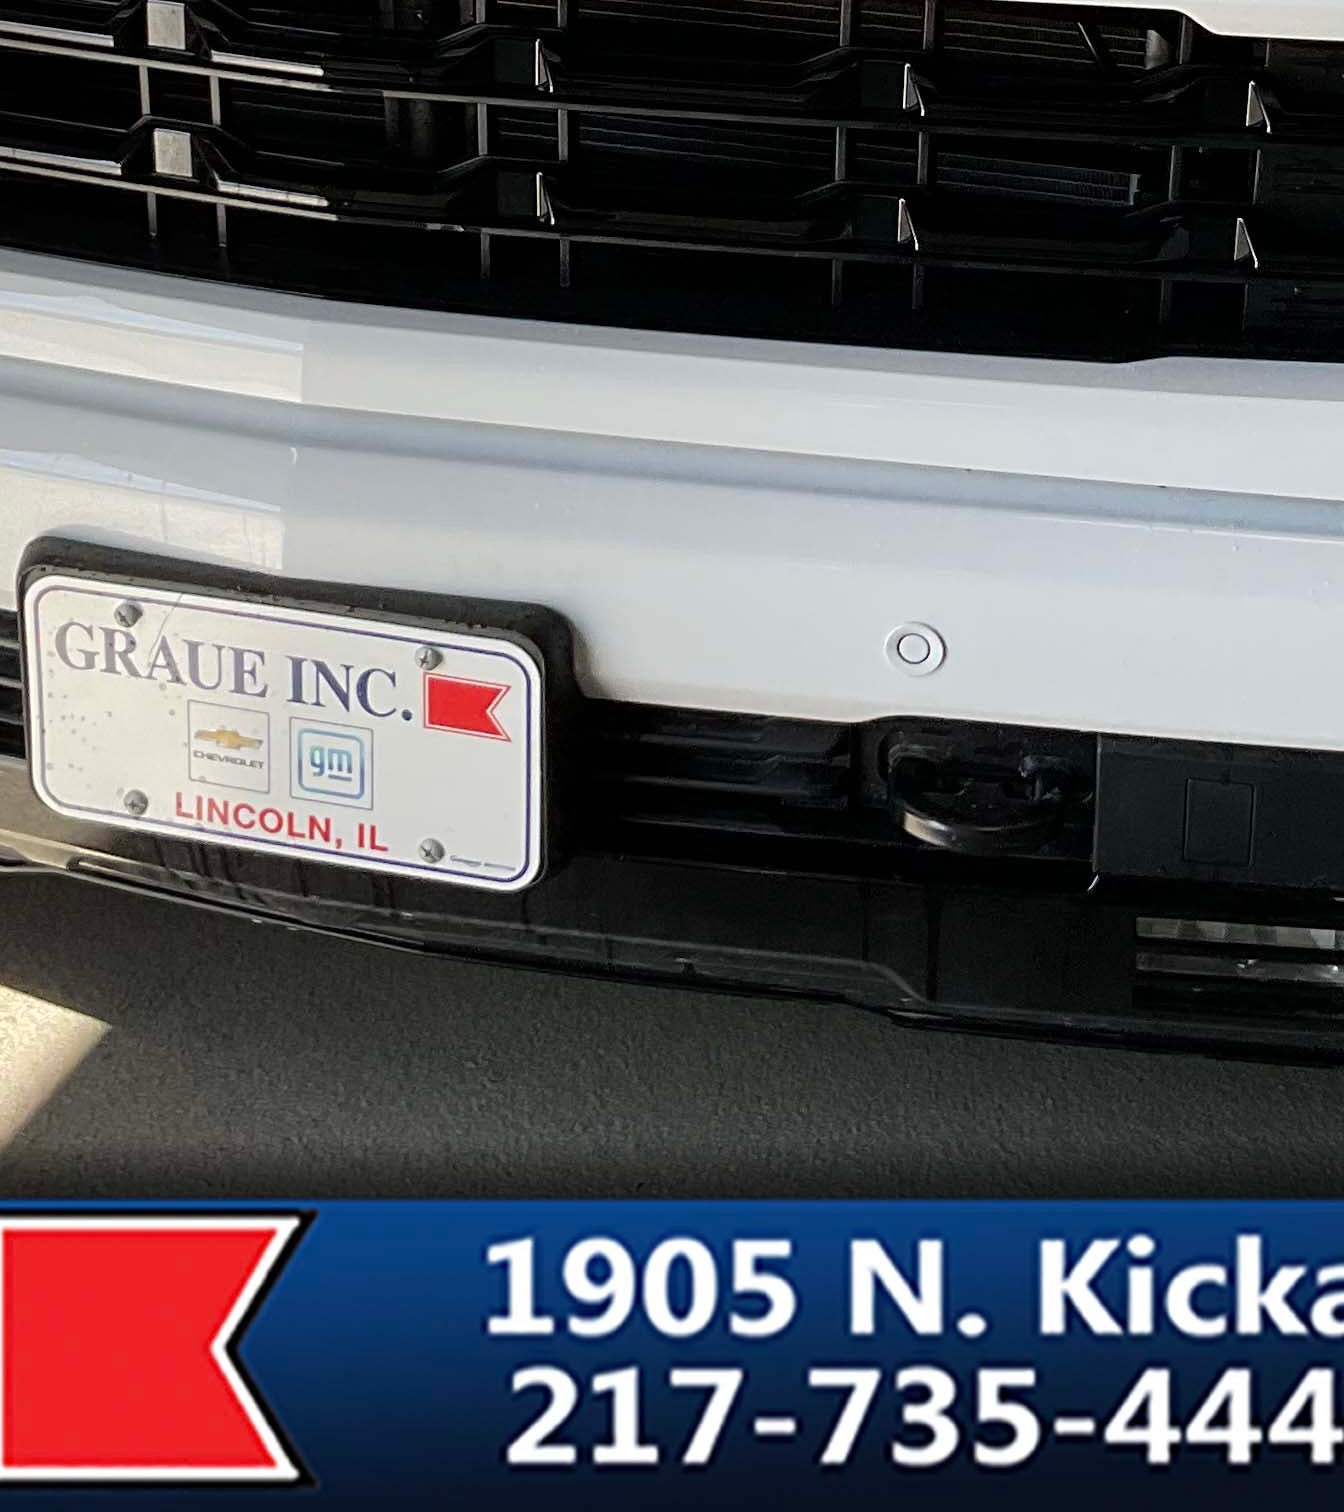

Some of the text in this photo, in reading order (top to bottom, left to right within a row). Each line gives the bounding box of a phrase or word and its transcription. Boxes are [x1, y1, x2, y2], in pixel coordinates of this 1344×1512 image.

[54, 620, 413, 721] GRAUE INC.
[193, 750, 265, 769] CHEVROLET
[309, 745, 353, 779] gm
[175, 791, 389, 852] LINCOLN, IL
